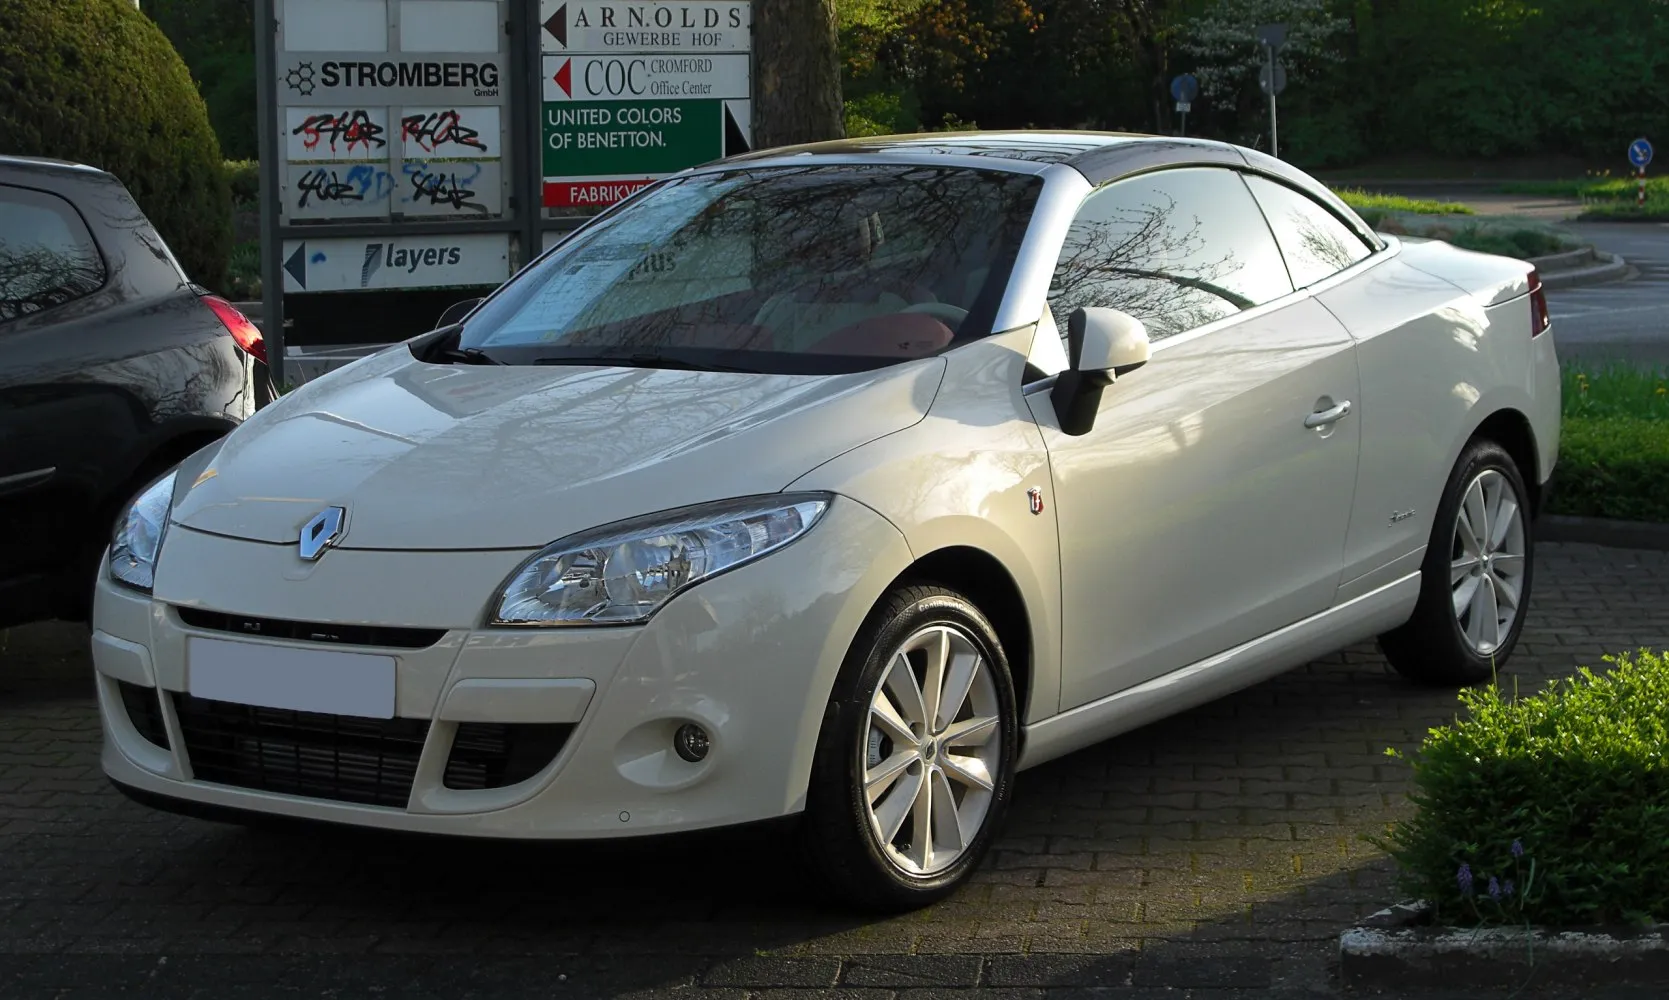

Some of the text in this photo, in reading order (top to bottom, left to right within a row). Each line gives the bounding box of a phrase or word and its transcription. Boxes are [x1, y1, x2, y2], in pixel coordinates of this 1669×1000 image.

[603, 32, 722, 46] GEWERBE HOF
[321, 61, 498, 87] STROMBERG
[651, 59, 713, 74] CROMFORD
[585, 59, 646, 96] COC
[474, 89, 499, 97] GmbH
[651, 80, 712, 96] Office Center
[549, 107, 682, 126] UNITED COLORS
[549, 131, 667, 149] OF BENETTON.
[570, 184, 650, 203] FABRIKV
[386, 243, 461, 273] layers
